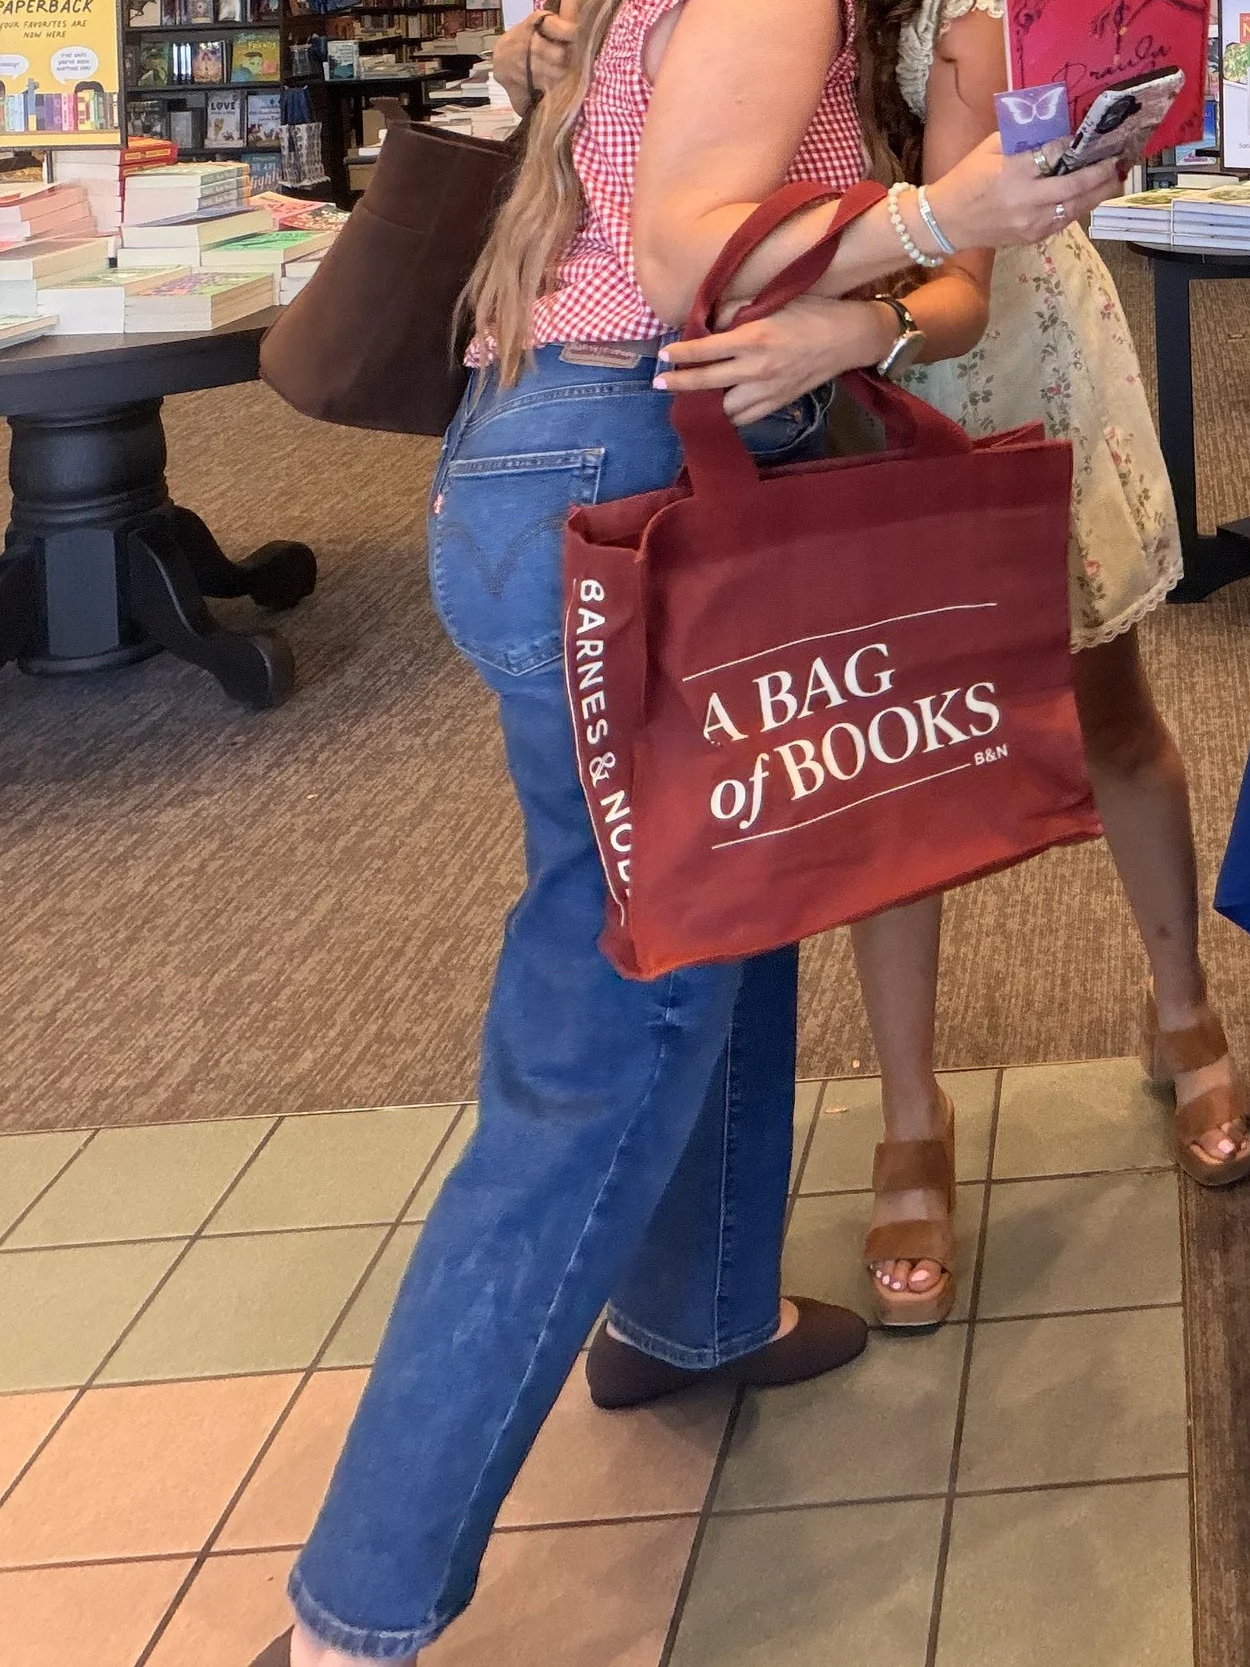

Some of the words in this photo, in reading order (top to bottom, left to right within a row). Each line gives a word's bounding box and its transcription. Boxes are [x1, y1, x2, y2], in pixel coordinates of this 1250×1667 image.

[0, 21, 20, 30] YOUR
[24, 20, 67, 29] FAVORITES
[210, 101, 236, 111] LOVE
[575, 579, 608, 745] BARNES
[702, 692, 749, 746] A
[752, 643, 896, 733] BAG
[589, 752, 616, 787] &
[710, 752, 770, 830] of
[773, 682, 1001, 802] BOOKS
[974, 744, 1009, 766] B&N
